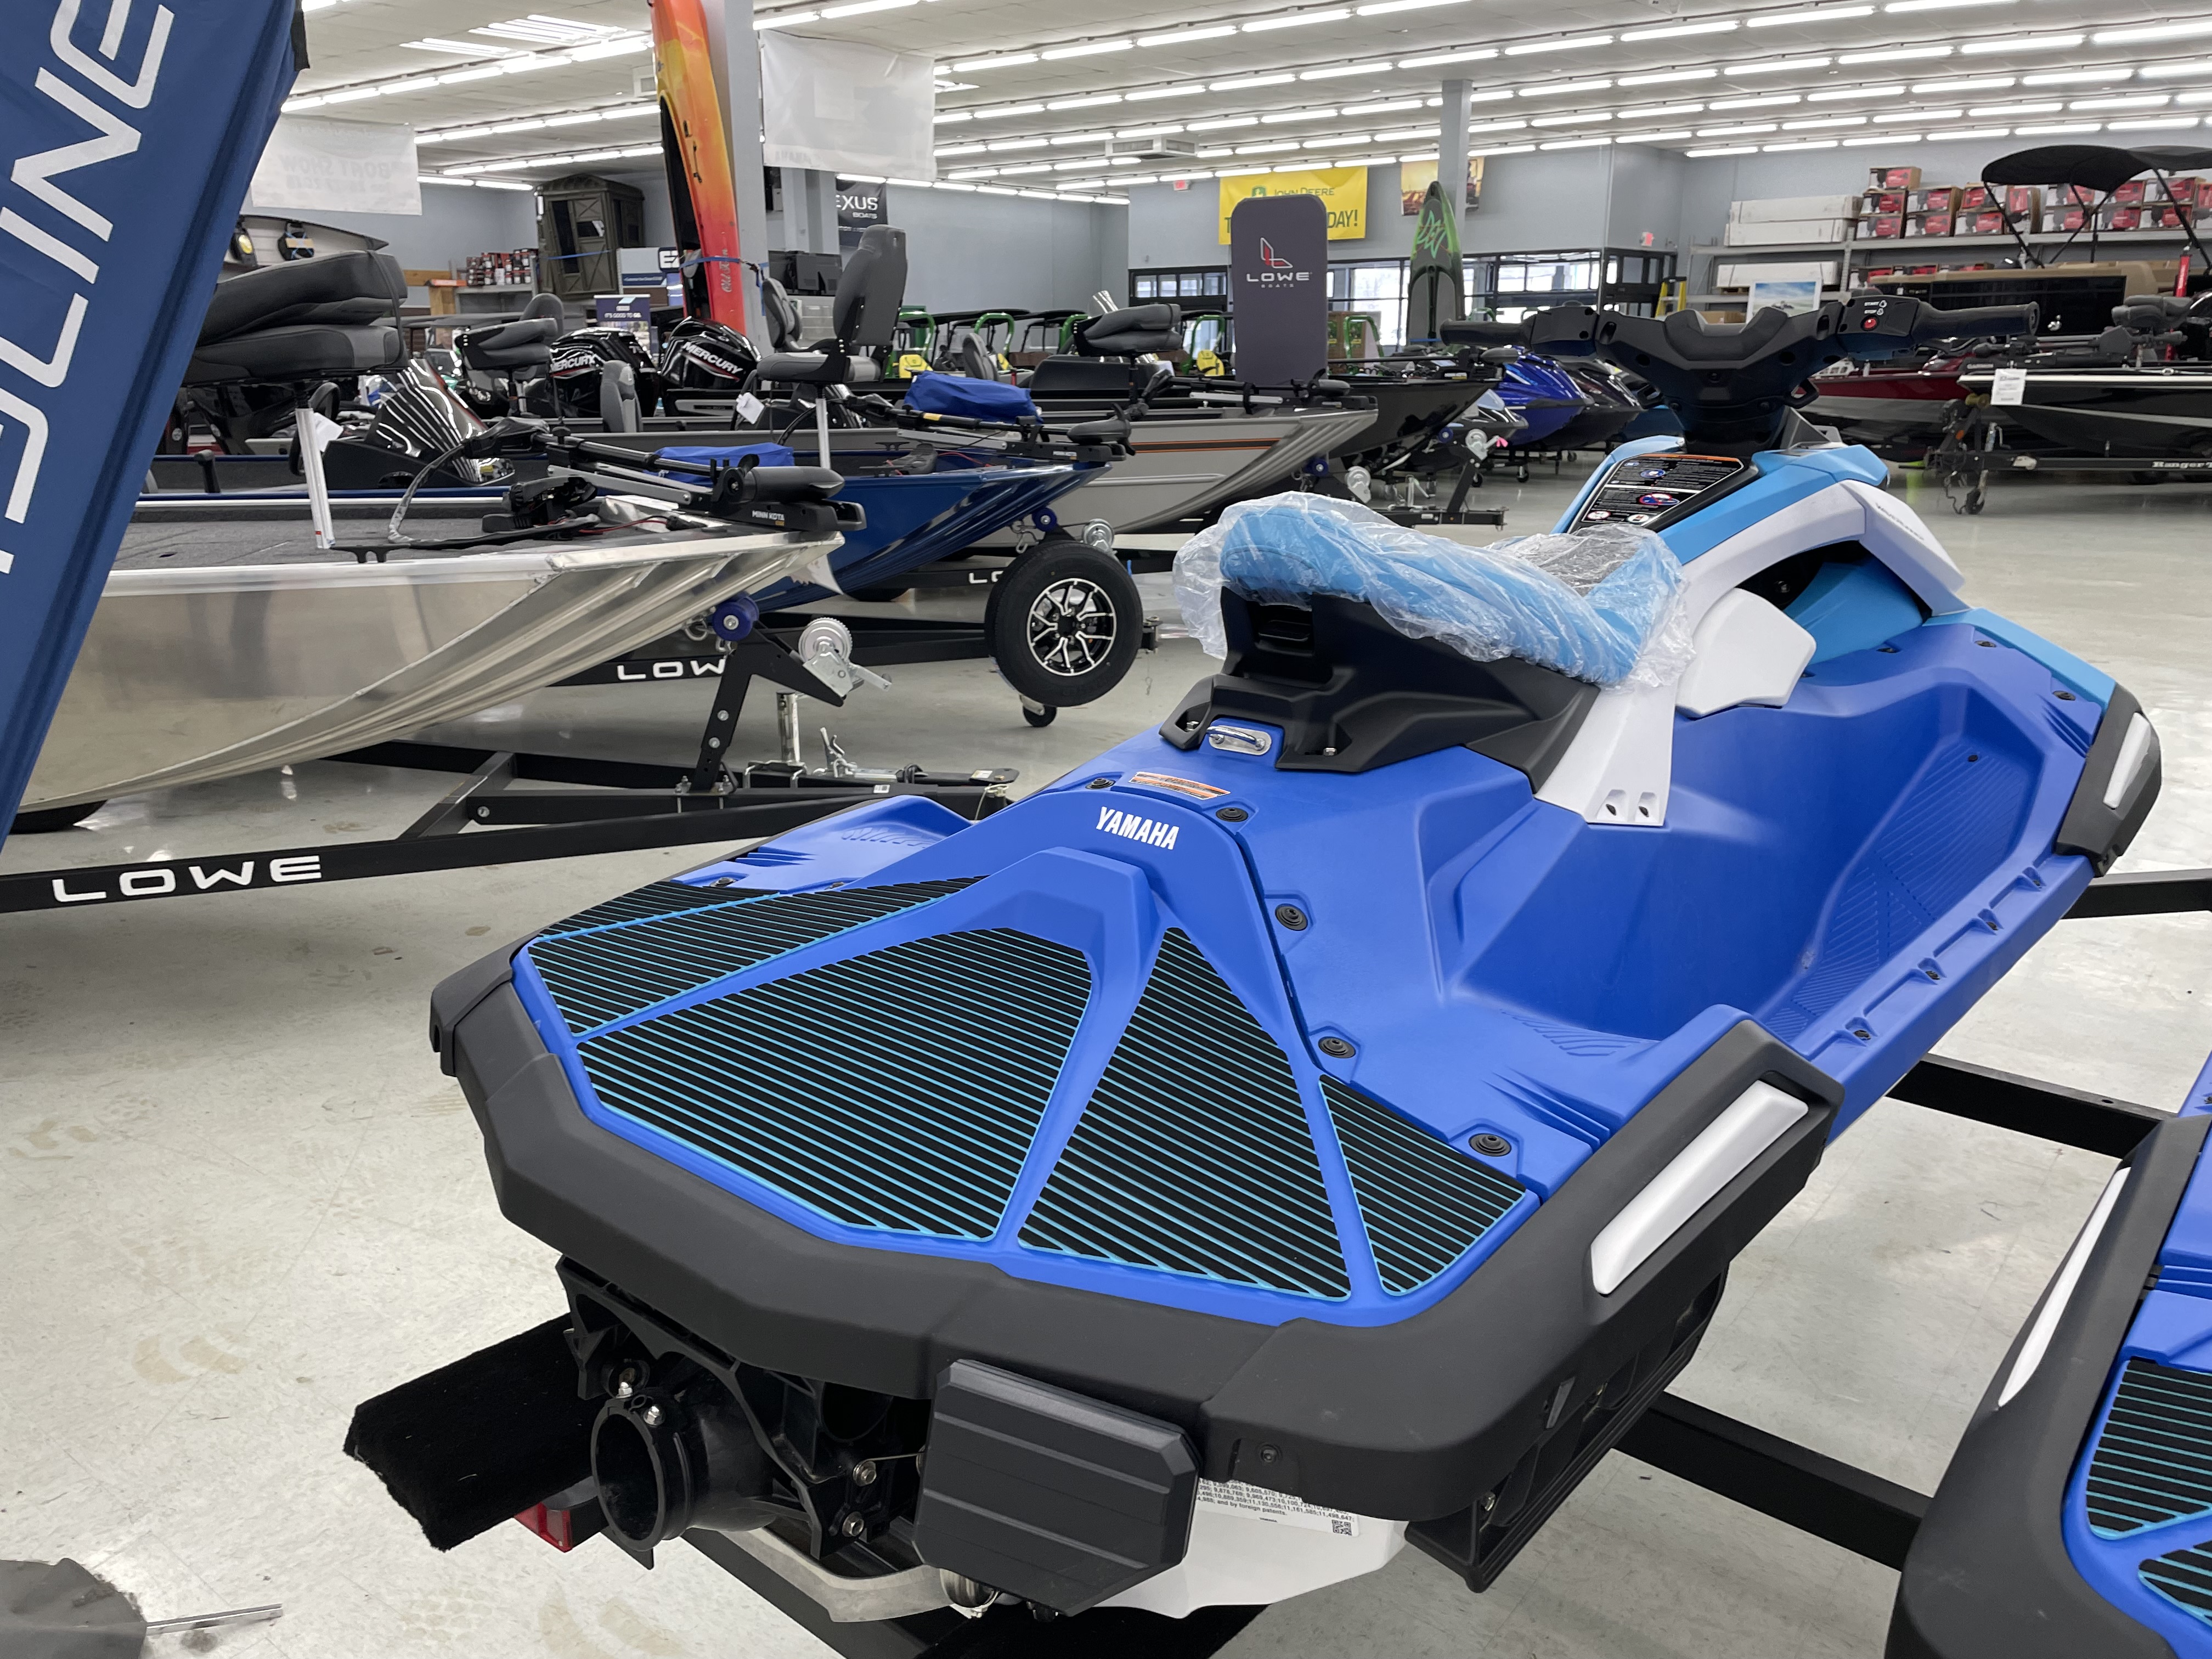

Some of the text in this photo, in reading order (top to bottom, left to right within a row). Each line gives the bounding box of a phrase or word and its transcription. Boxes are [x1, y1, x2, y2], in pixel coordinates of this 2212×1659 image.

[836, 194, 878, 211] EXUS
[1246, 272, 1310, 282] LOWE
[550, 351, 596, 370] MERCURY
[681, 341, 743, 374] MERCURY
[769, 512, 785, 521] KOTA
[617, 658, 727, 681] LOW
[1096, 806, 1180, 850] YAMAHA
[52, 855, 323, 902] LOWE
